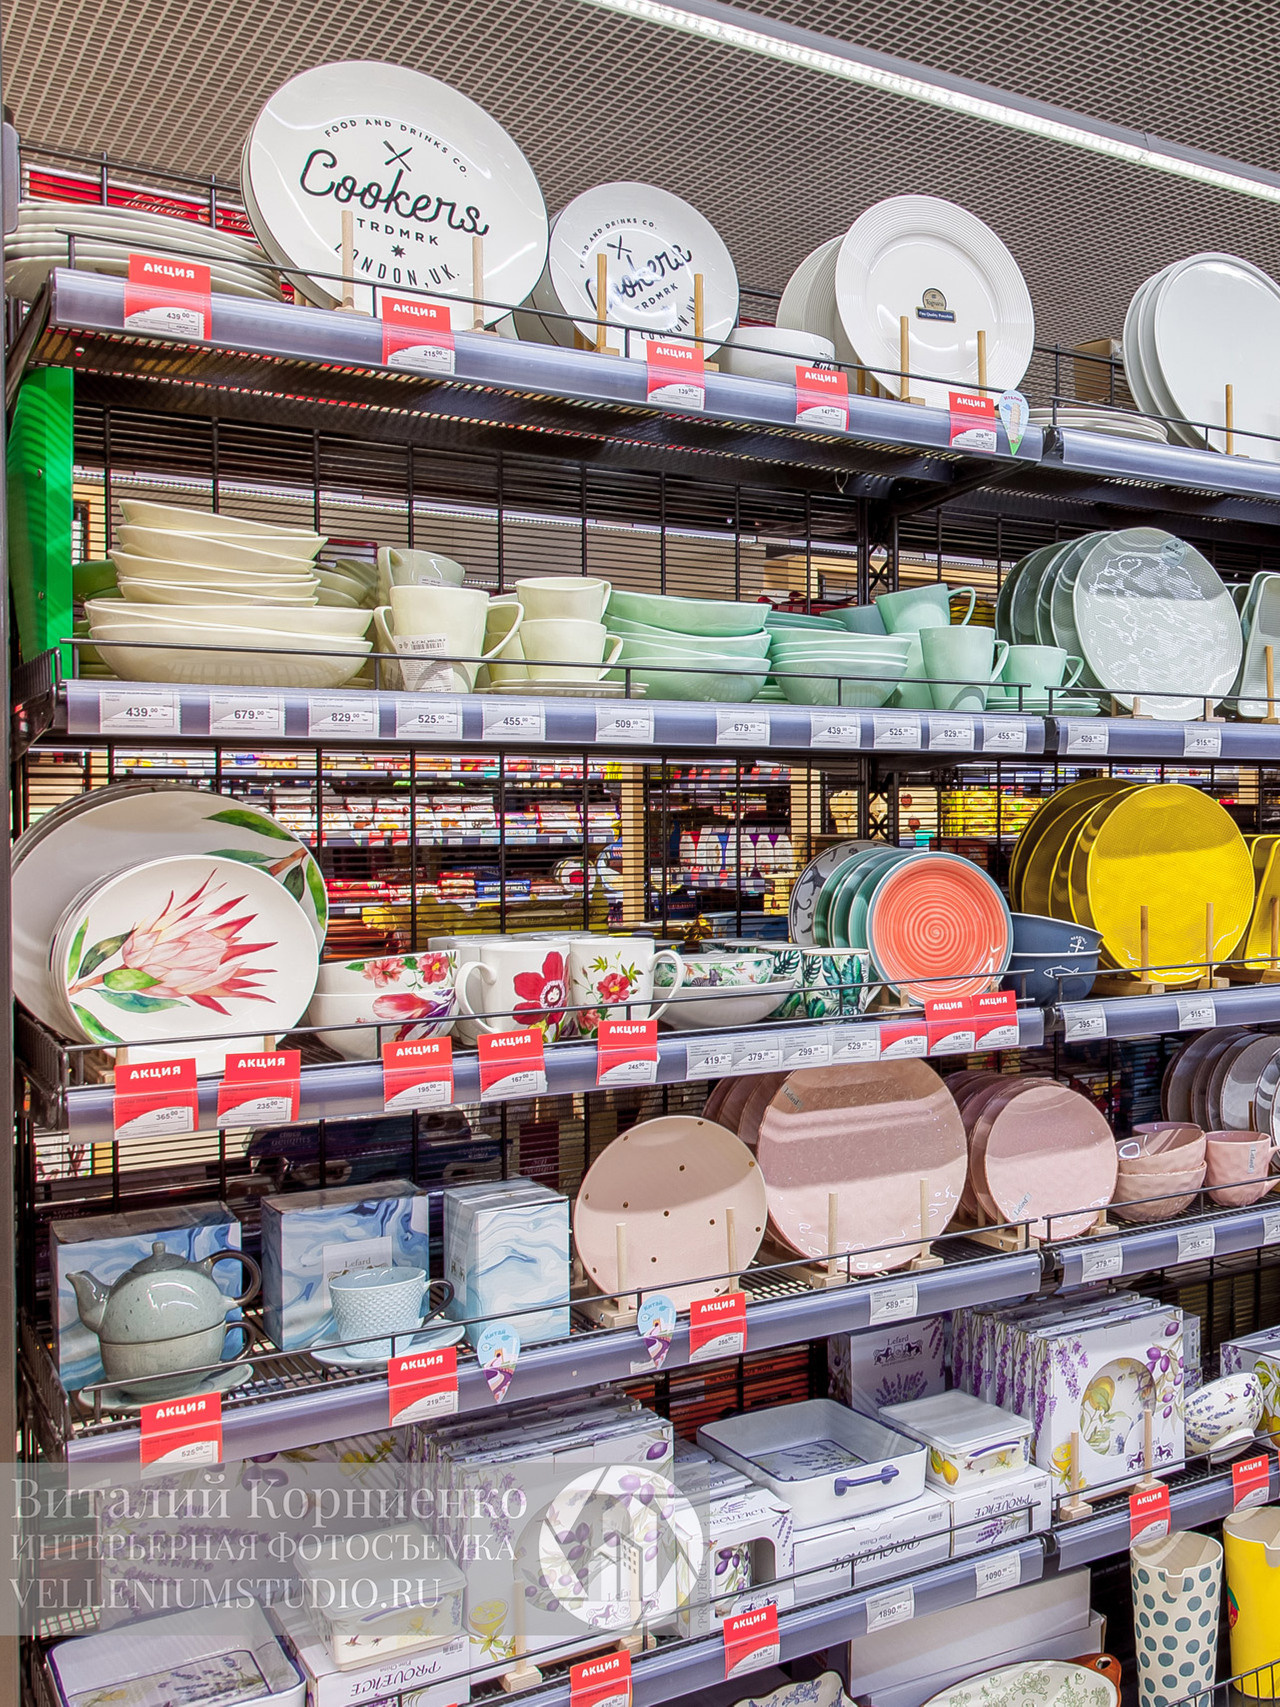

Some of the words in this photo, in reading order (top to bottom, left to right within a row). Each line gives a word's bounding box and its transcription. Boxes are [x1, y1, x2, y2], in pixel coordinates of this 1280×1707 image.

[325, 119, 357, 138] FOOD
[365, 119, 392, 128] AND
[400, 124, 448, 154] DRINKS
[452, 157, 468, 178] CO.
[300, 149, 490, 236] Cookers
[356, 217, 439, 247] TRDMRK
[589, 228, 603, 243] AND
[605, 217, 638, 229] DRINKS
[642, 219, 657, 230] CO.
[144, 263, 195, 279] АКЦИЯ
[393, 303, 437, 318] АКЦИЯ
[655, 347, 693, 360] АКЦИЯ
[804, 371, 838, 384] АКЦИЯ
[956, 397, 986, 408] АКЦИЯ
[125, 707, 158, 717] 439.00
[234, 710, 264, 720] 679.00
[331, 713, 360, 722] 829.00
[418, 714, 445, 724] 525.00
[503, 717, 529, 726] 455.00
[932, 1001, 963, 1011] АКЦИЯ
[979, 996, 1008, 1007] АКЦИЯ
[609, 1025, 647, 1035] АКЦИЯ
[490, 1035, 532, 1048] АКЦИЯ
[396, 1044, 440, 1057] АКЦИЯ
[237, 1057, 286, 1069] АКЦИЯ
[130, 1065, 181, 1080] АКЦИЯ
[256, 1100, 278, 1110] 235.00
[156, 1110, 178, 1121] 365.00
[344, 1256, 371, 1268] Lefard
[700, 1299, 736, 1314] АКЦИЯ
[400, 1355, 443, 1371] АКЦИЯ
[156, 1401, 206, 1419] АКЦИЯ
[1239, 1461, 1263, 1473] АКЦИЯ
[1137, 1492, 1162, 1506] АКЦИЯ
[732, 1613, 767, 1630] АКЦИЯ
[581, 1659, 620, 1678] АКЦИЯ
